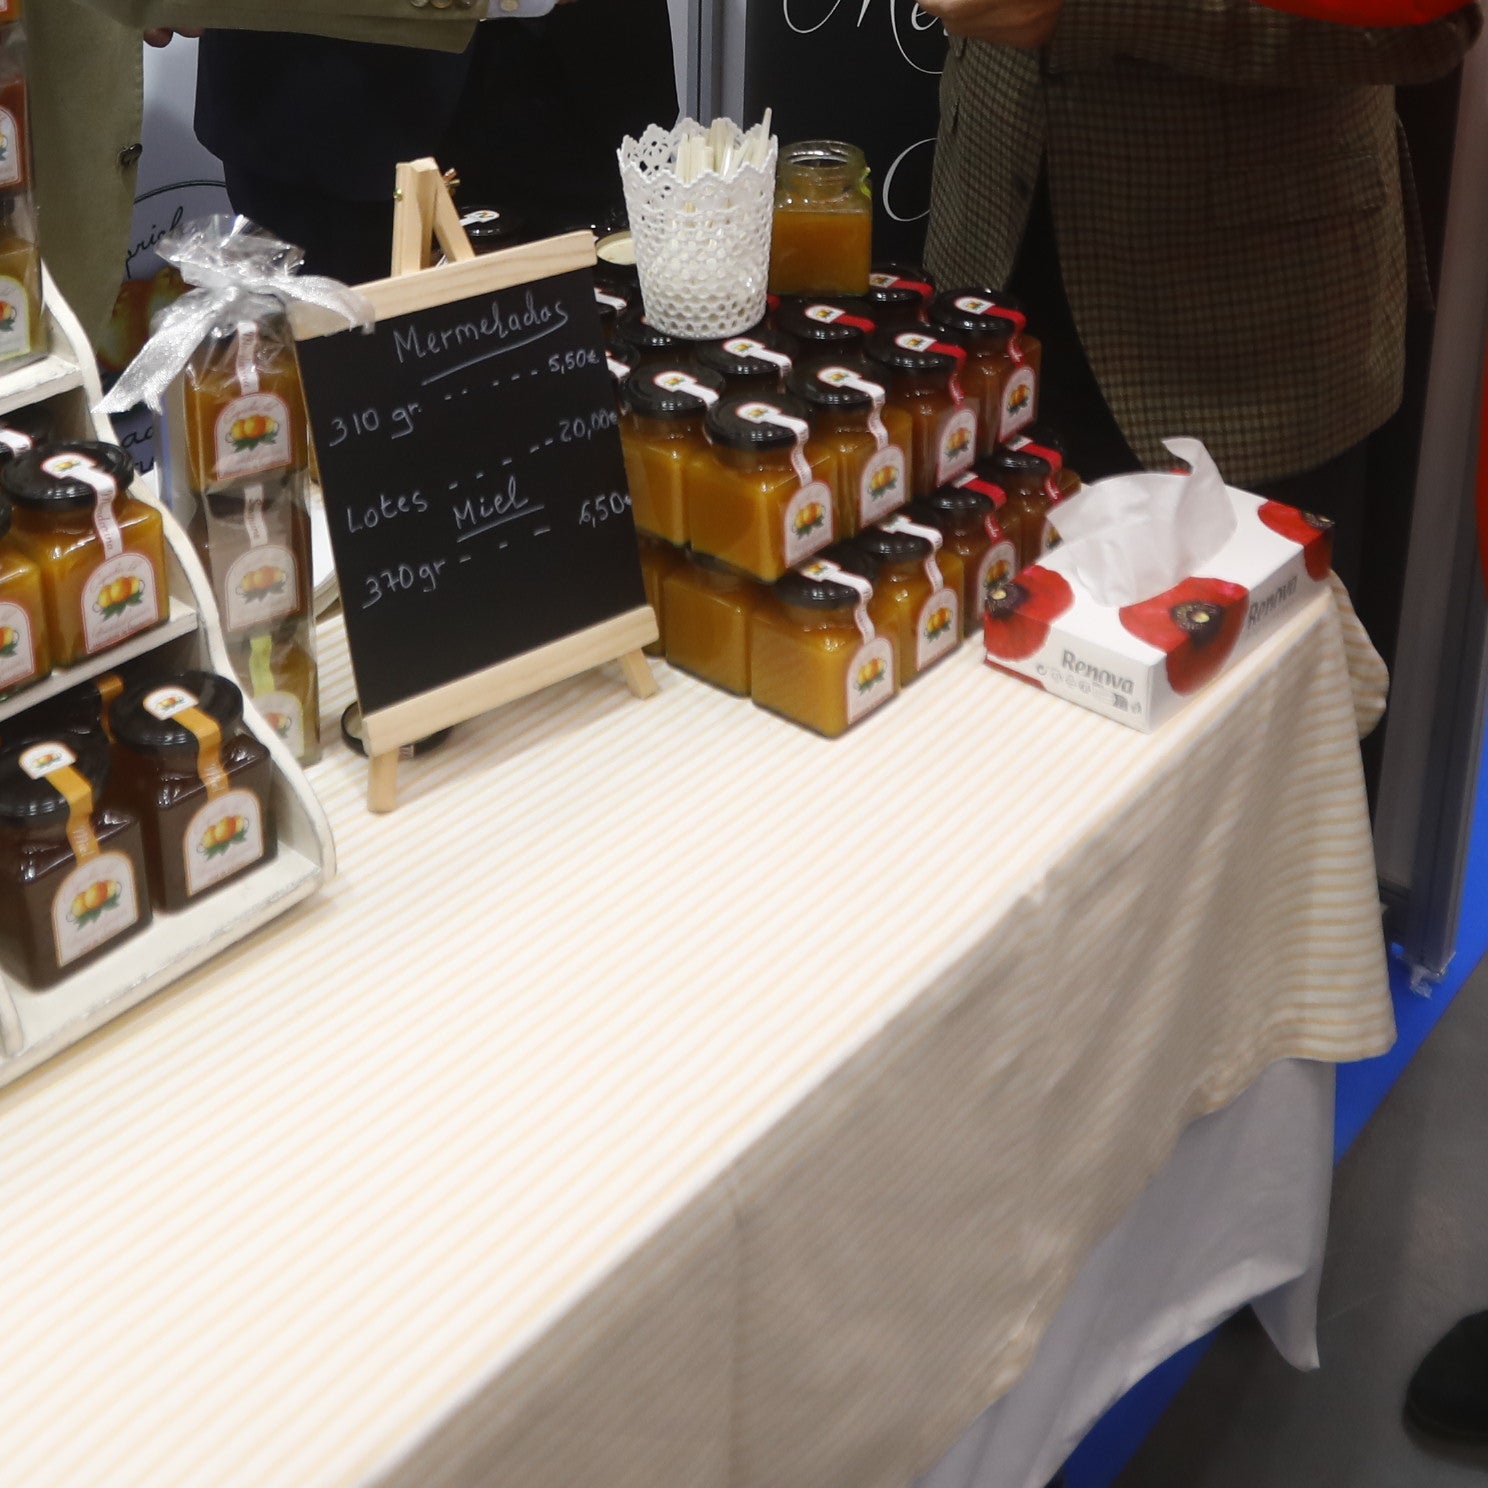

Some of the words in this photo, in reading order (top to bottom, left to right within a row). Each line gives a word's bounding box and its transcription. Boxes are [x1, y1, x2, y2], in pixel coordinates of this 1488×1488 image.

[329, 410, 381, 448] 310
[346, 488, 430, 535] Lotes
[452, 476, 531, 530] Miel
[1247, 575, 1299, 631] Renova
[1062, 649, 1136, 695] Renova
